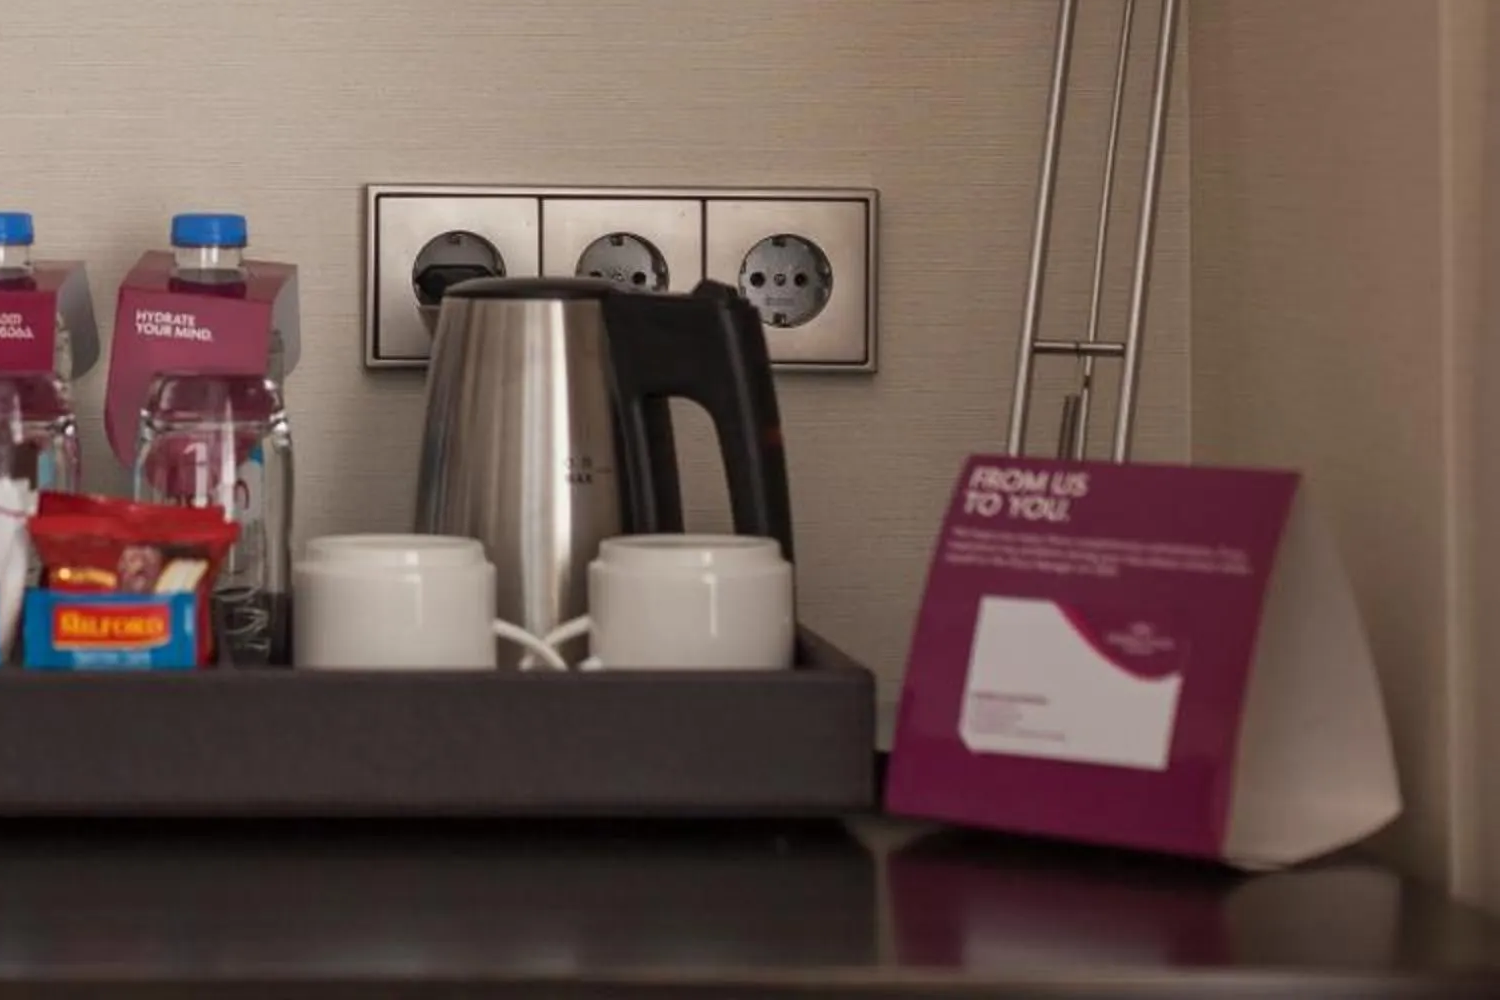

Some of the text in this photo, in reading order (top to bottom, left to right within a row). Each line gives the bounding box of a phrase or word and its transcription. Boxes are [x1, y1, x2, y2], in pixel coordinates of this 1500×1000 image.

[136, 310, 196, 327] HYDRATE
[136, 323, 172, 337] YOUR
[968, 466, 1090, 498] FROM US
[964, 490, 1003, 518] TO
